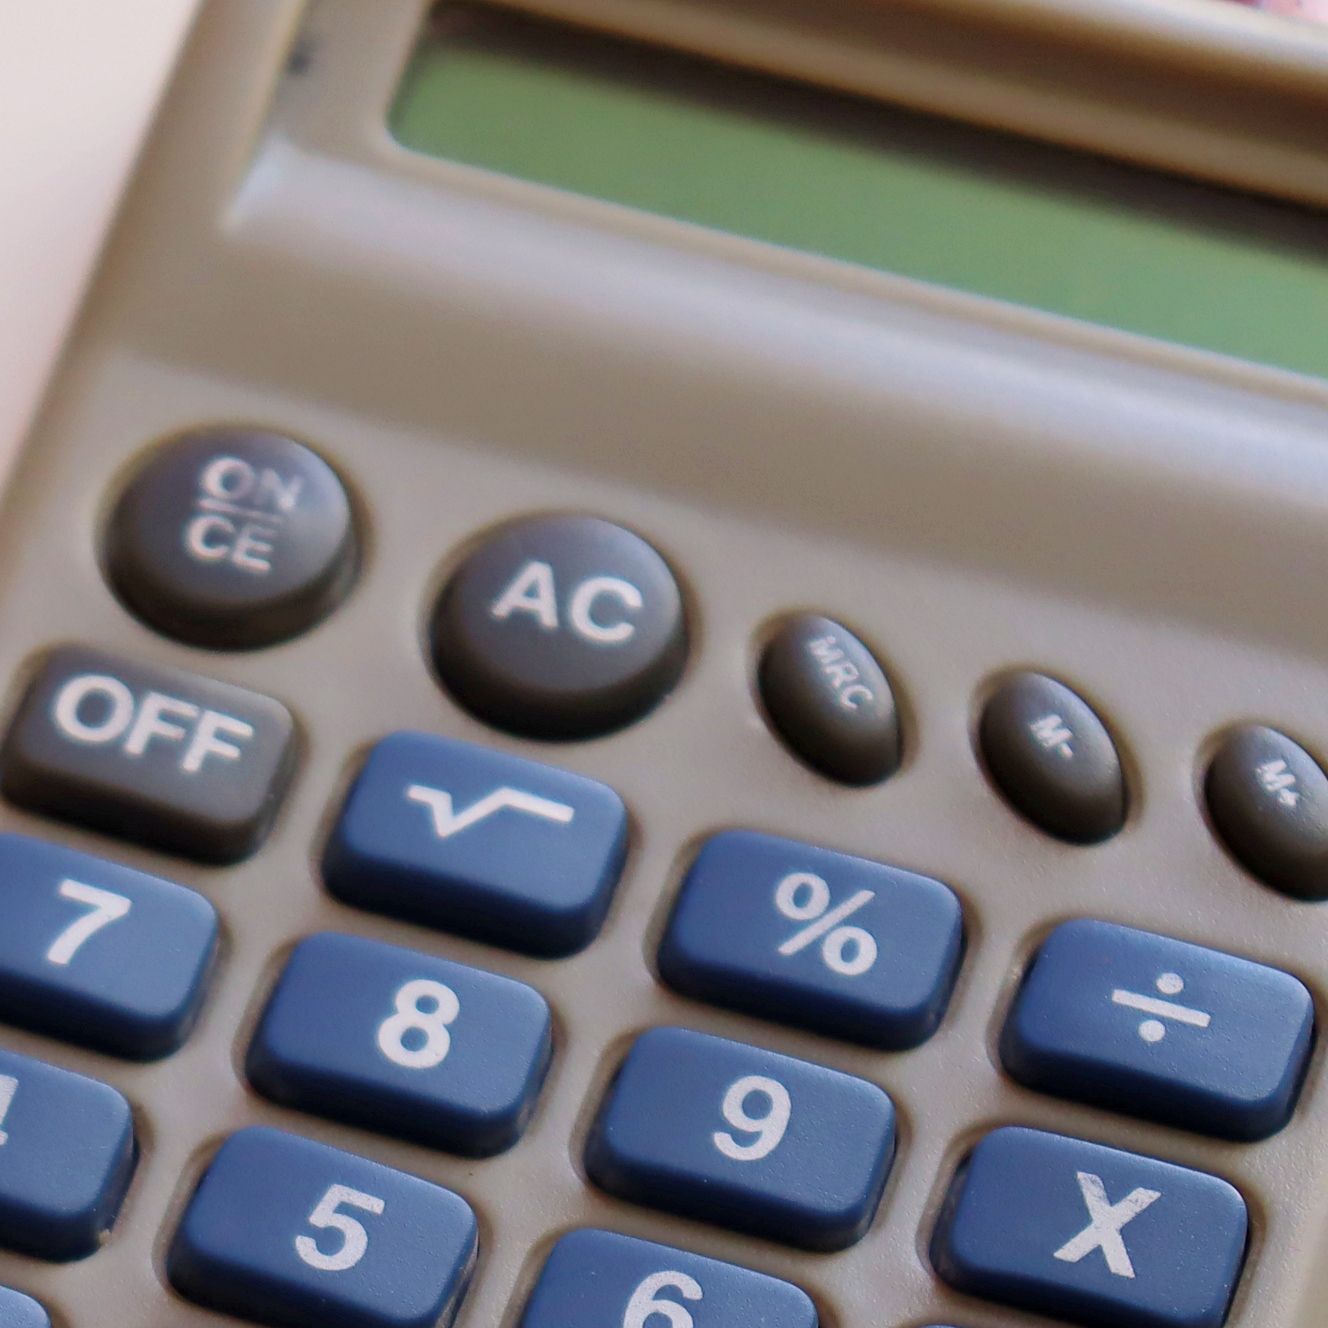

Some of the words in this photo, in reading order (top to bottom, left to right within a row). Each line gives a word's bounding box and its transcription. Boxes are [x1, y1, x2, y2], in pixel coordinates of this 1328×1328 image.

[201, 457, 304, 512] ON
[186, 515, 275, 574] CE
[491, 560, 644, 643] AC
[808, 635, 874, 710] MRC
[53, 673, 254, 774] OFF
[47, 879, 132, 966] 7
[774, 872, 878, 977] %
[377, 979, 460, 1069] 8
[713, 1075, 792, 1161] 9
[294, 1183, 386, 1271] 5
[1053, 1170, 1162, 1279] X
